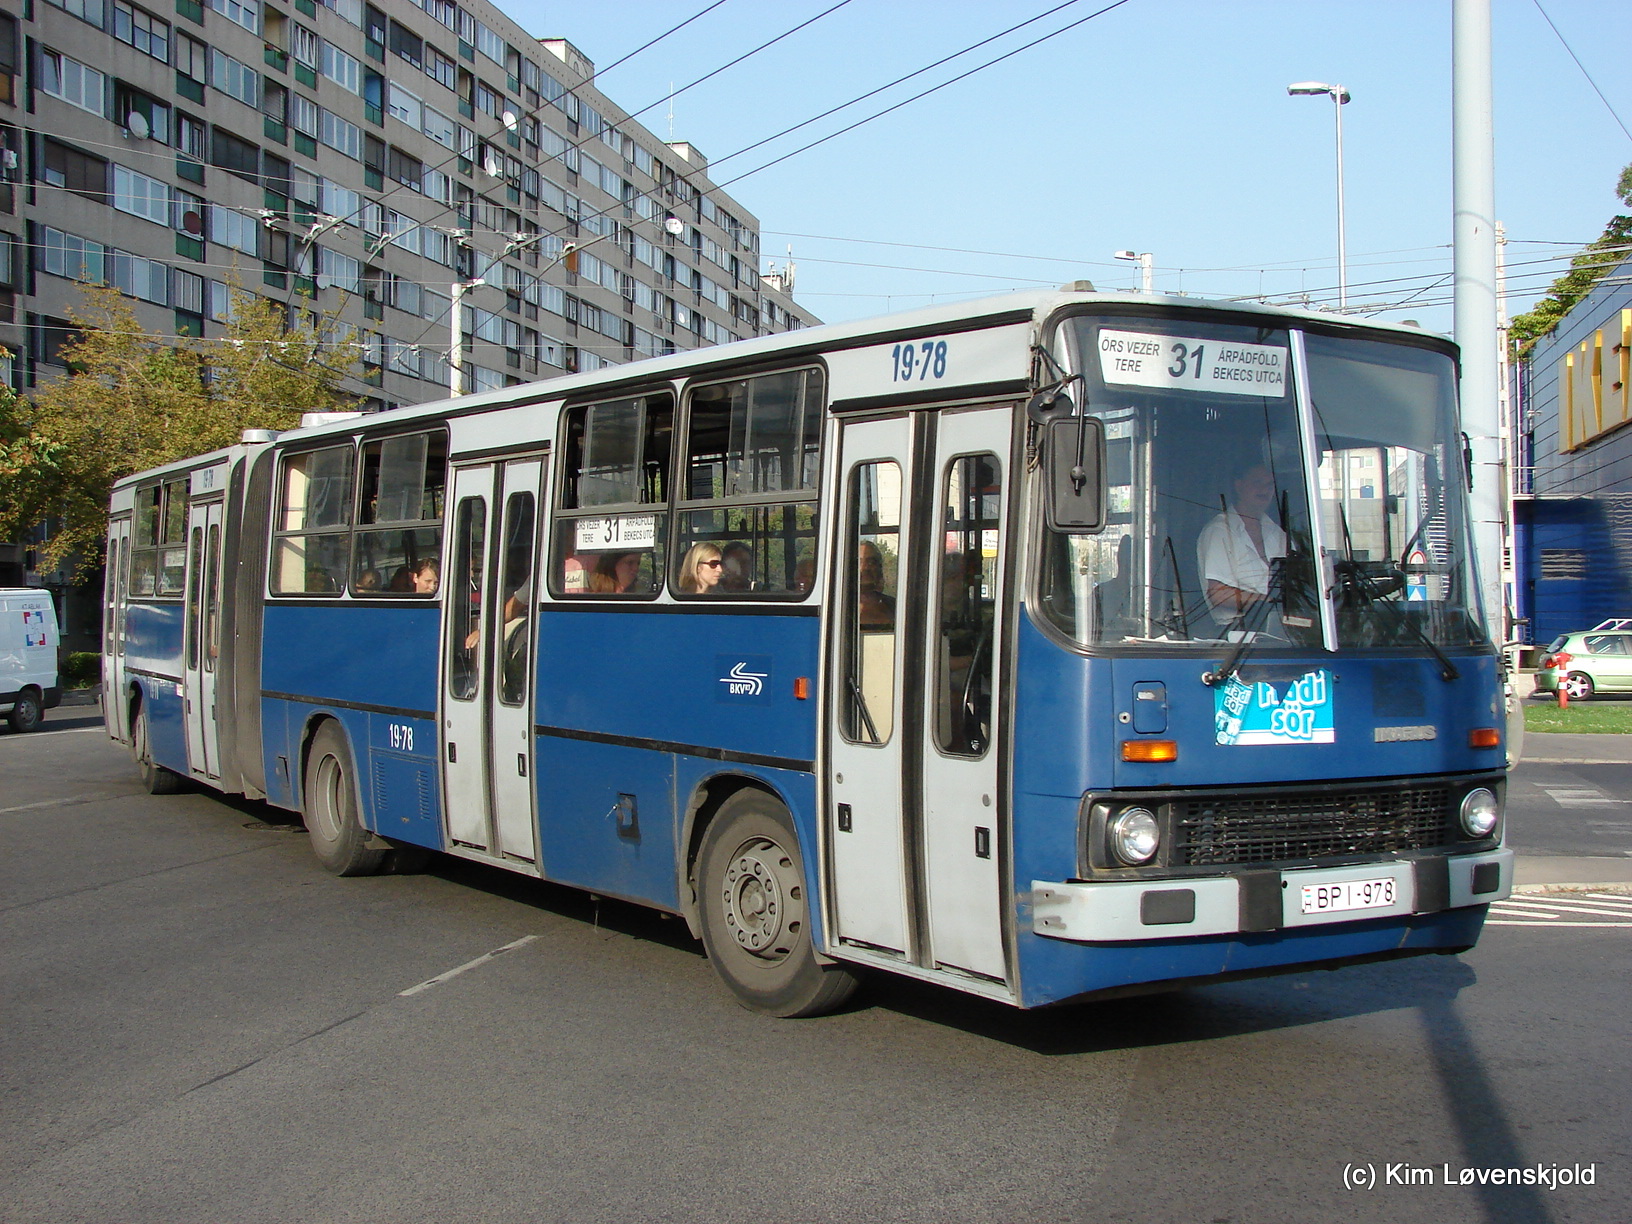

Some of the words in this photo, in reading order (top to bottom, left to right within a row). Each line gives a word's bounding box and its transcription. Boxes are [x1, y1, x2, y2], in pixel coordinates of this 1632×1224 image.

[1101, 336, 1124, 353] ÖRS
[1127, 339, 1160, 356] VEZÉR
[1114, 358, 1142, 373] TERE
[1167, 343, 1204, 379] 31
[1213, 366, 1253, 382] BEKECS
[1255, 370, 1283, 384] UTCA
[582, 533, 594, 543] TERE
[604, 517, 620, 543] 31
[624, 530, 642, 541] BEKECS
[1271, 702, 1315, 738] sör
[1304, 900, 1312, 910] H
